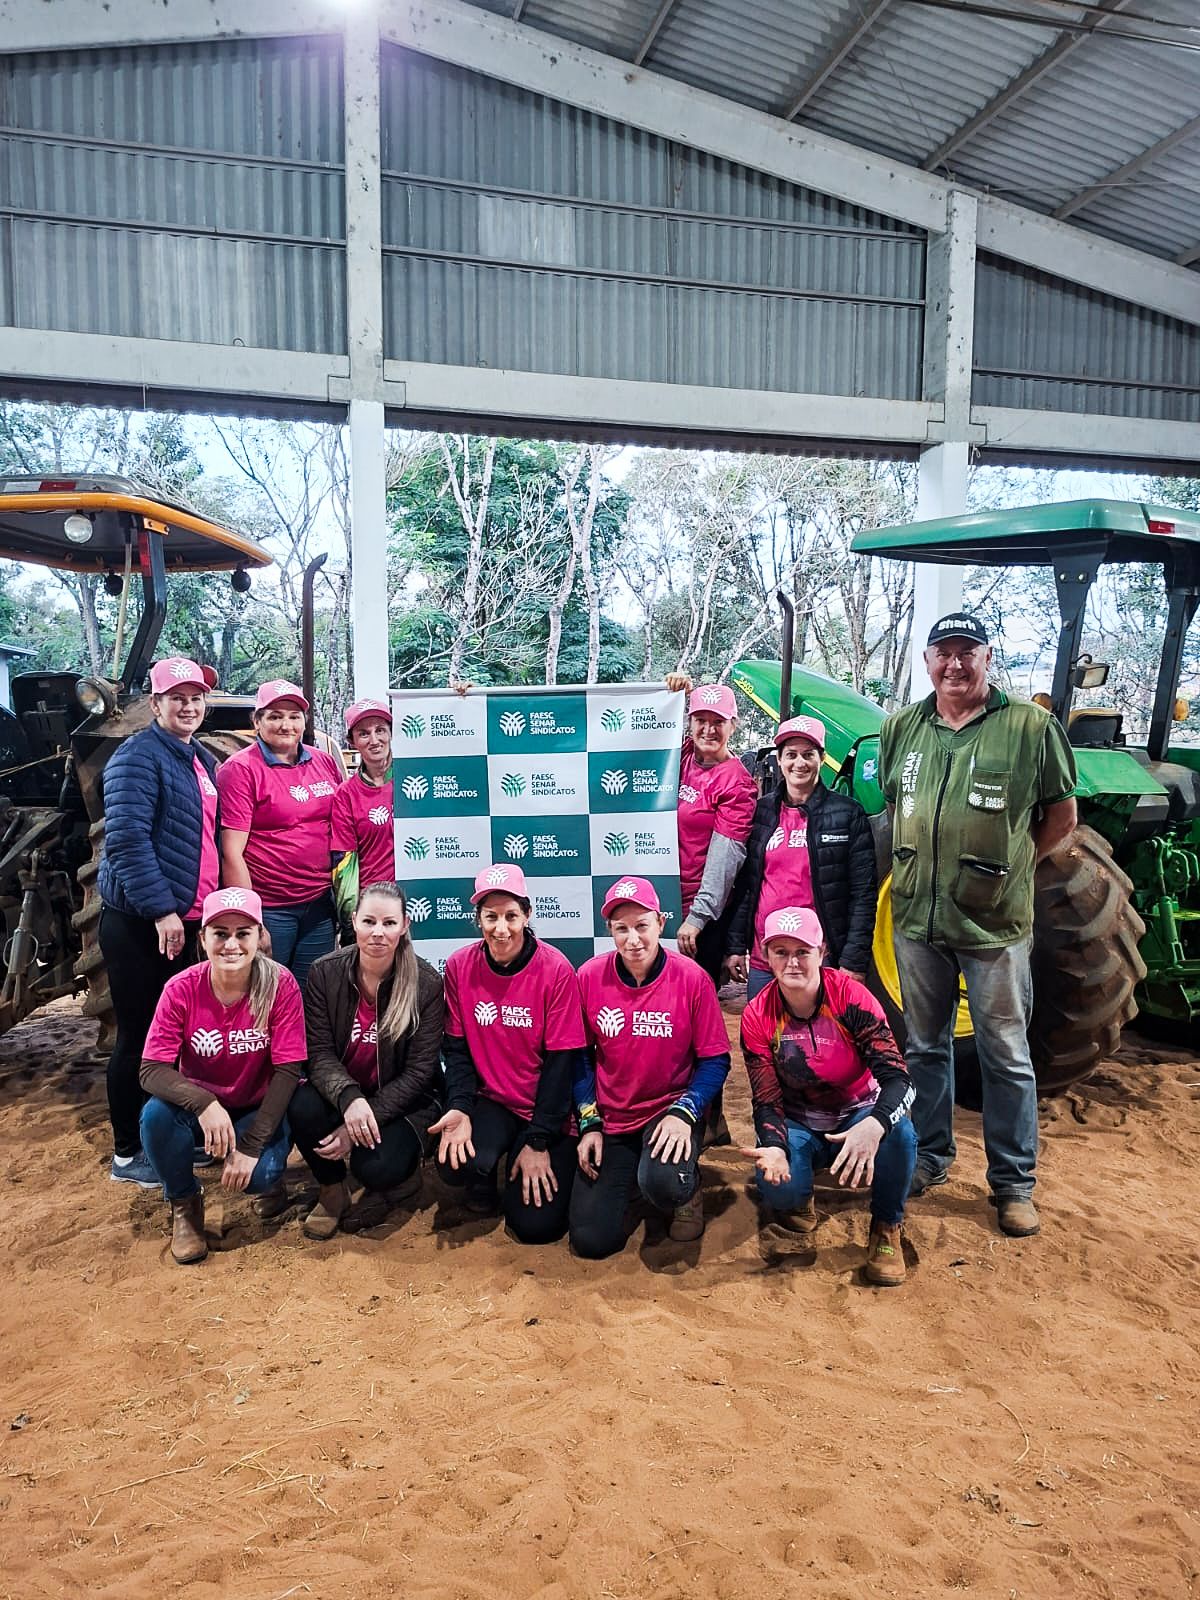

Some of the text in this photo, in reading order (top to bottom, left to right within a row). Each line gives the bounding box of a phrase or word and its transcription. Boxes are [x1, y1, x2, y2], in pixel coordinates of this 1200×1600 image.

[631, 707, 654, 715] FAESC
[430, 714, 454, 722] FAESC
[530, 719, 556, 727] SENAR
[631, 722, 676, 730] SINDICATOS
[431, 729, 475, 737] SINDICATOS
[530, 727, 576, 735] SINDICATOS
[902, 752, 918, 792] SENAR
[531, 773, 555, 781] FAESC
[632, 777, 658, 785] SENAR
[531, 788, 576, 796] SINDICATOS
[632, 785, 674, 793] SINDICATOS
[433, 790, 478, 799] SINDICATOS
[634, 832, 655, 840] FAESC
[532, 842, 558, 850] SENAR
[634, 847, 671, 855] SINDICATOS
[436, 912, 477, 920] SINDICATO
[535, 911, 581, 919] SINDICATOS
[502, 1006, 531, 1016] FAESC
[632, 1011, 671, 1023] FAESC
[502, 1017, 533, 1028] SENAR
[631, 1024, 673, 1038] SENAR
